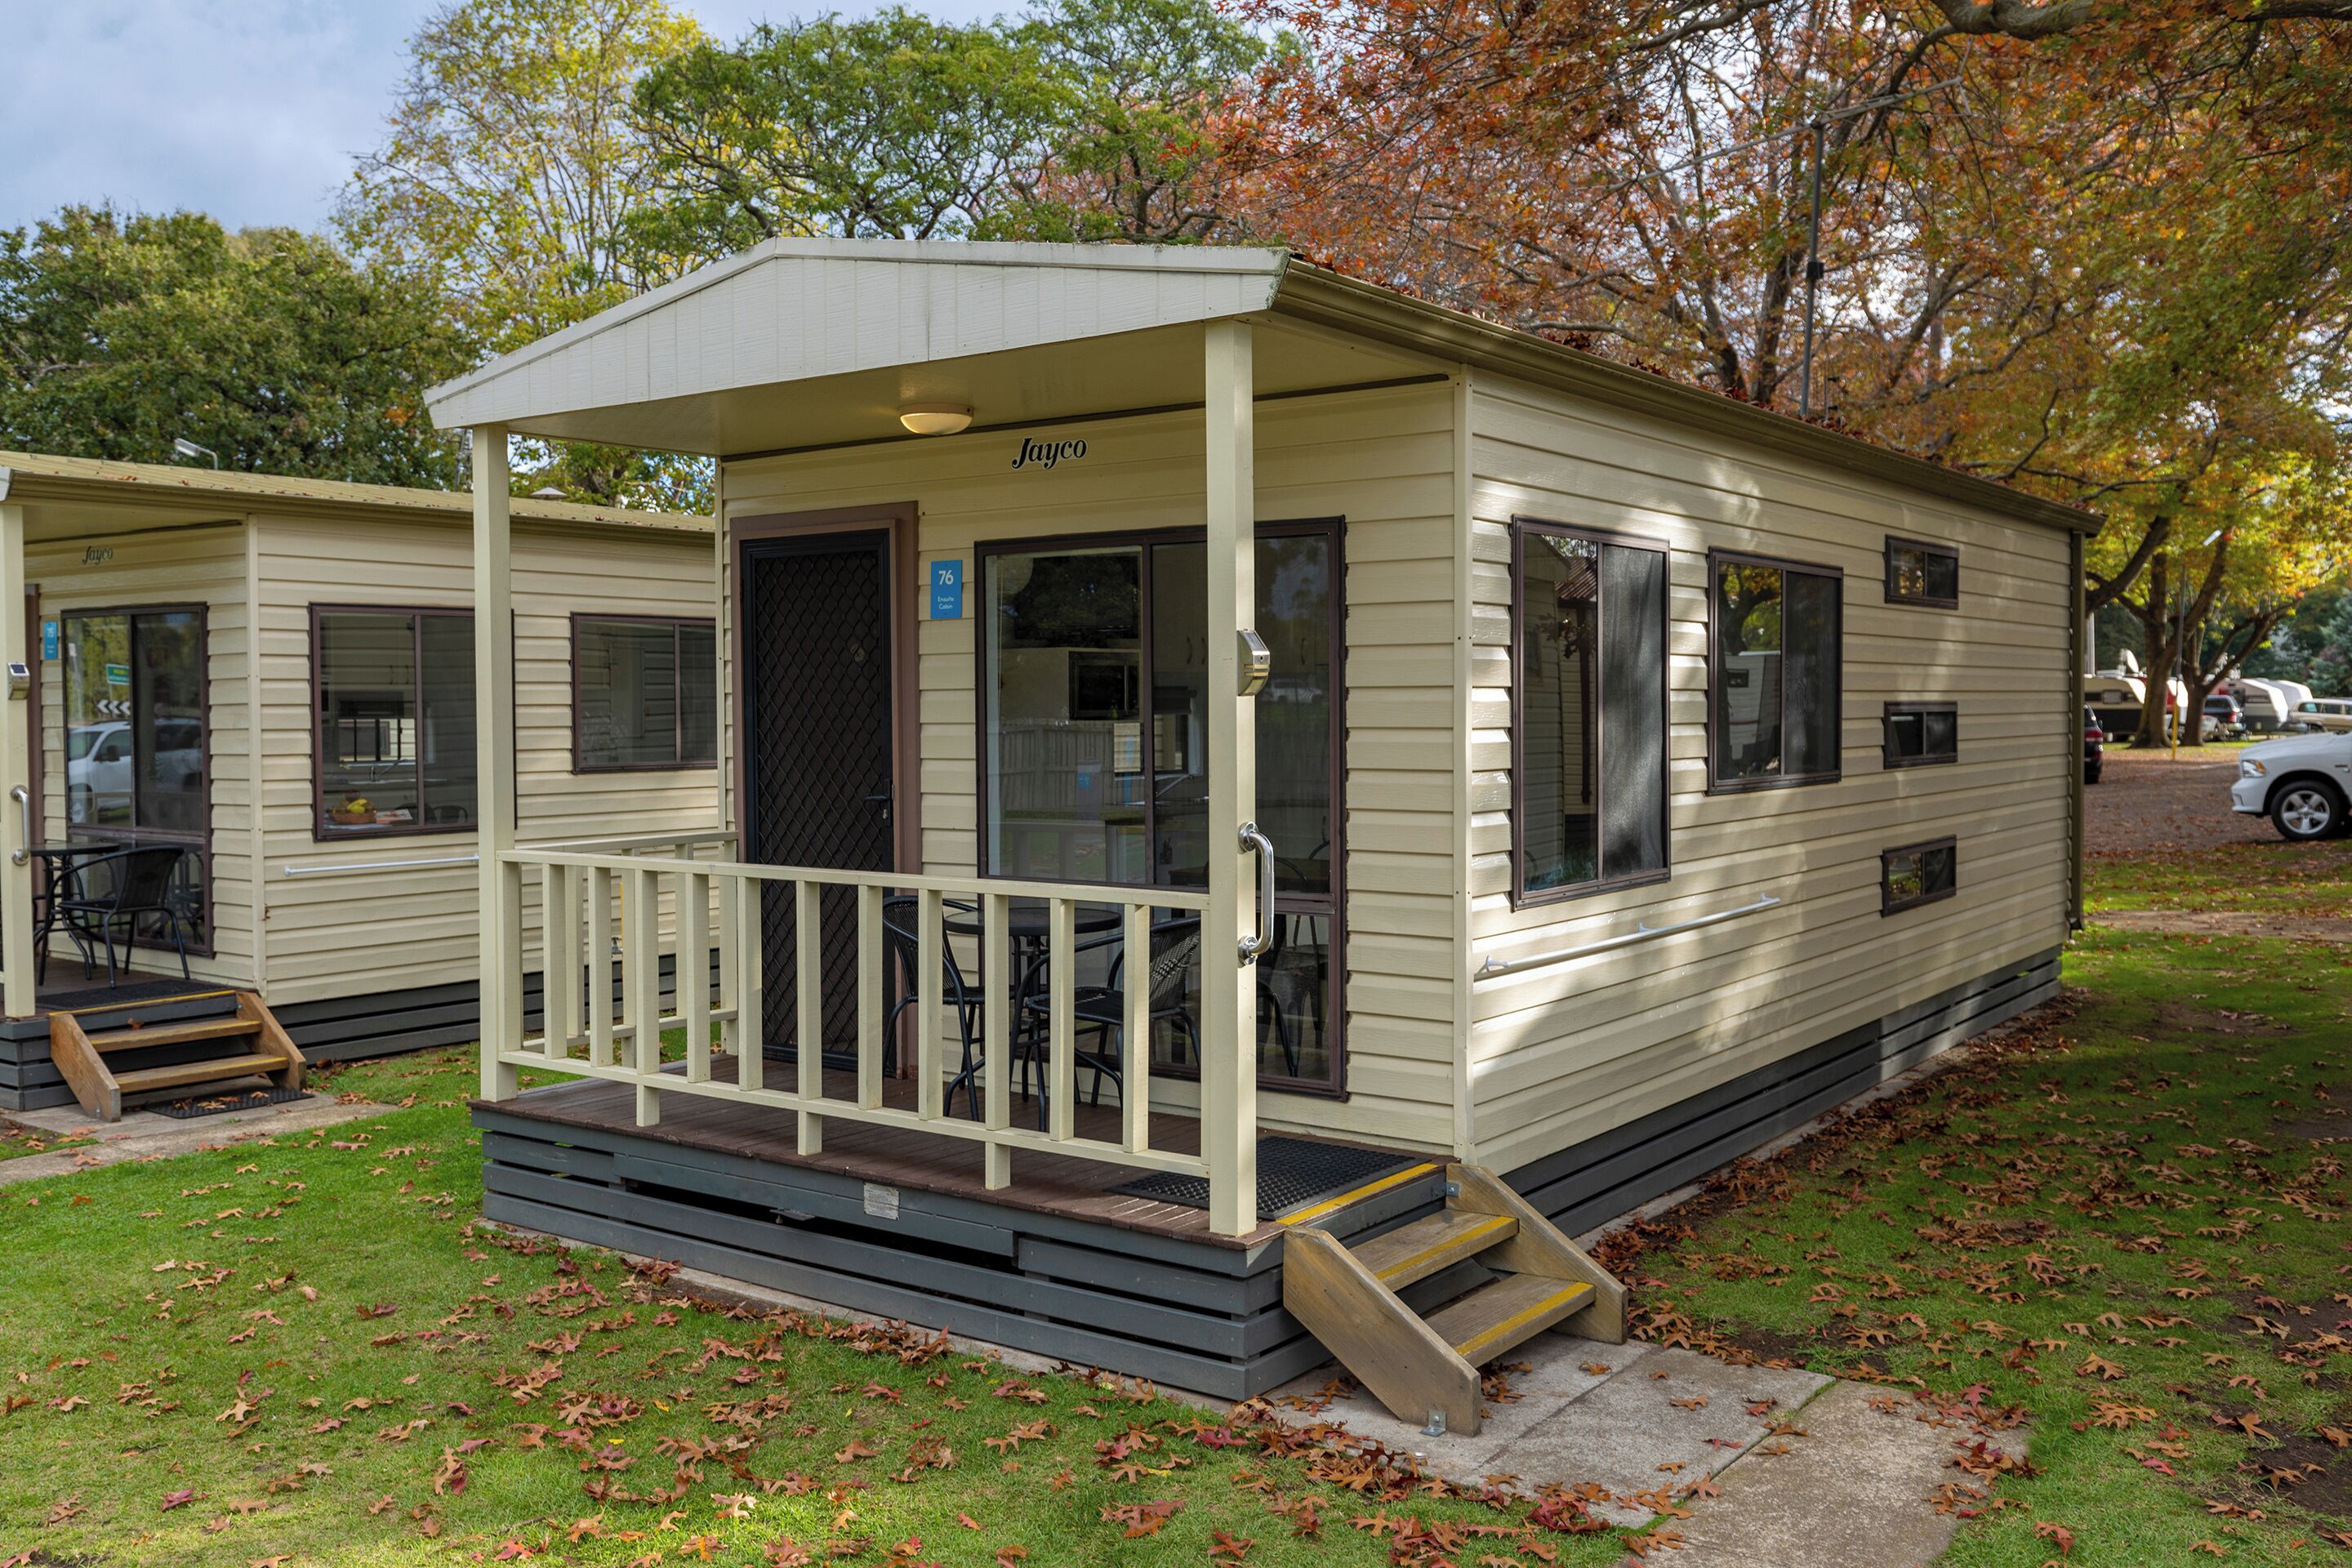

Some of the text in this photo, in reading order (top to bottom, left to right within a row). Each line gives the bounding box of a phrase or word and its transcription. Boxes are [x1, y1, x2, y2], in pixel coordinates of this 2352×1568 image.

[1012, 437, 1087, 469] Jayco
[82, 546, 114, 565] Jayco
[938, 569, 954, 586] 76
